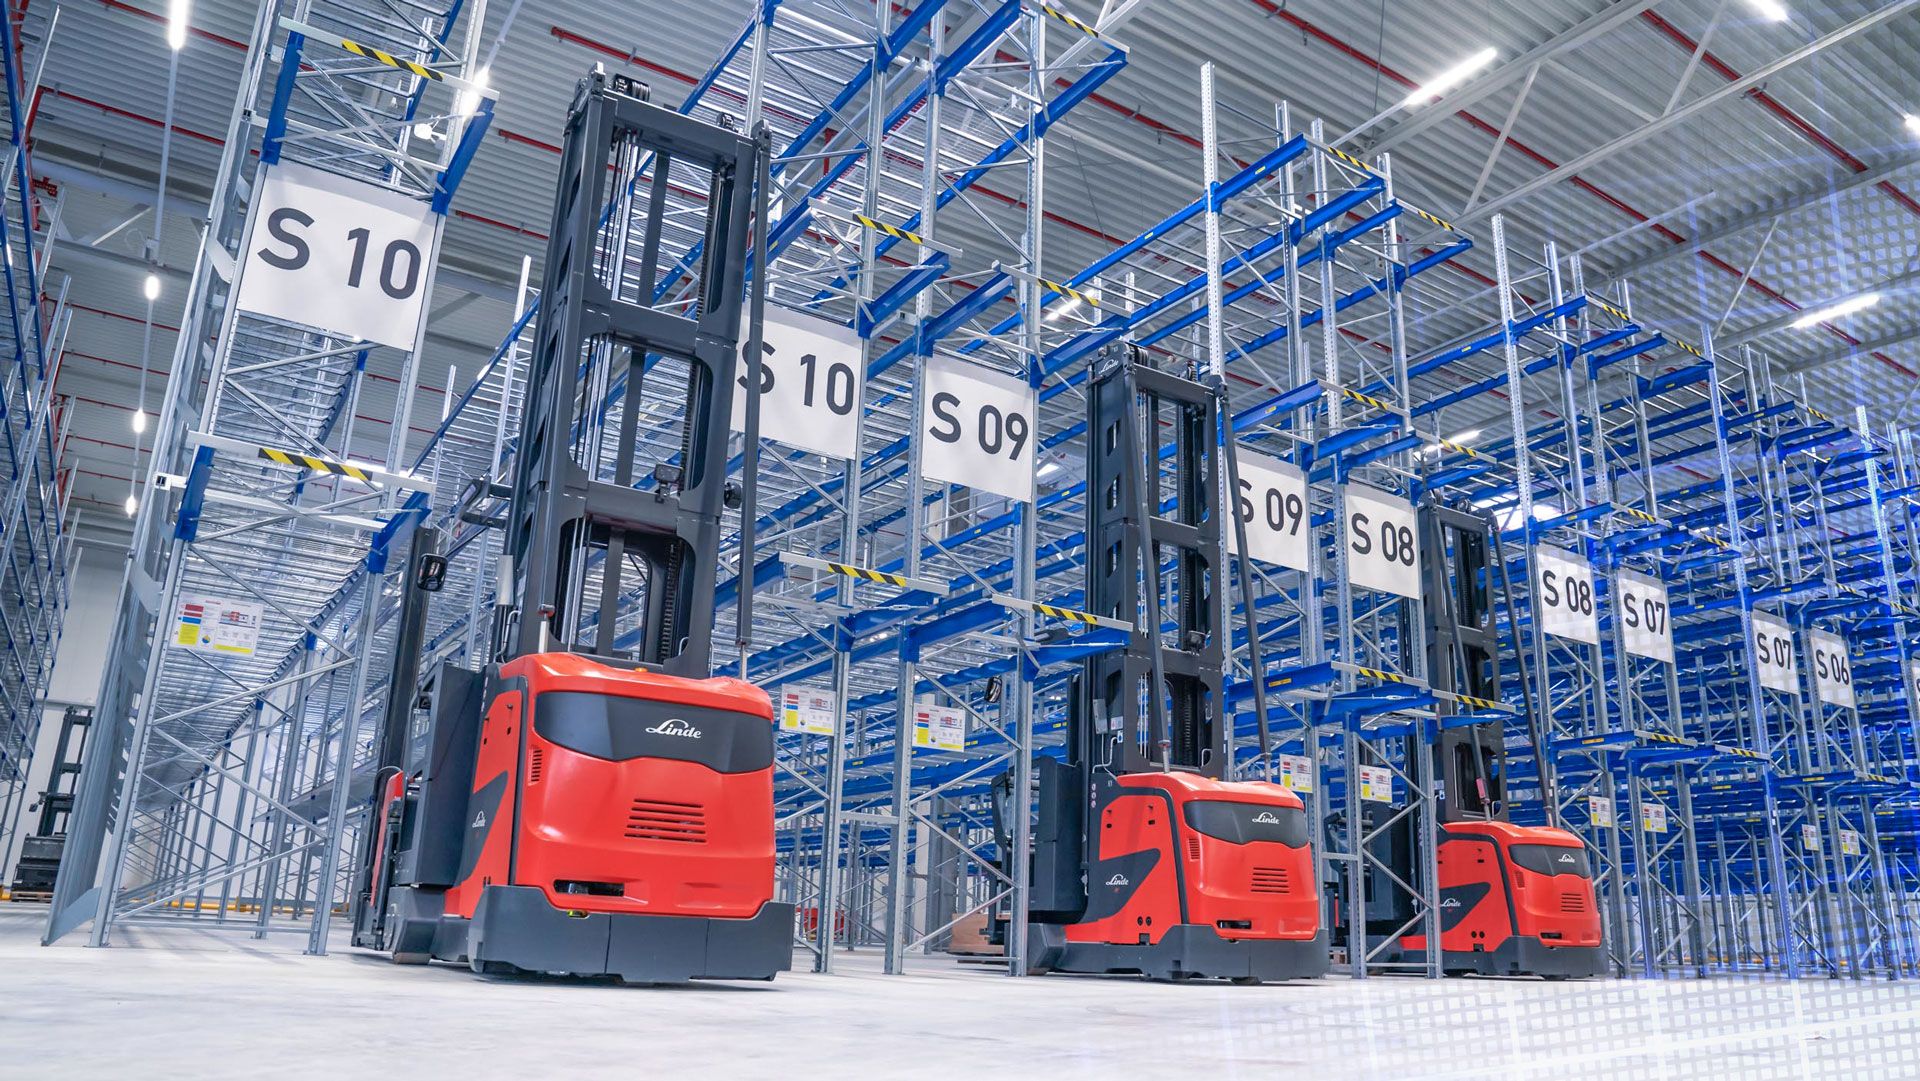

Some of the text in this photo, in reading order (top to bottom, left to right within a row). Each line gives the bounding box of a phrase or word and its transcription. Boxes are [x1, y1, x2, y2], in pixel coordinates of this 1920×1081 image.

[257, 207, 422, 300] S 10
[736, 339, 855, 416] S 10
[928, 391, 1029, 461] S 09
[1265, 487, 1303, 536] 09
[1351, 512, 1415, 567] S 08
[1542, 569, 1593, 617] S 08
[1623, 592, 1666, 636] S 07
[1756, 632, 1791, 670] S 07
[1815, 648, 1850, 686] S 06
[645, 718, 702, 739] Linde
[1251, 811, 1280, 824] Linde
[1105, 873, 1129, 886] Linde
